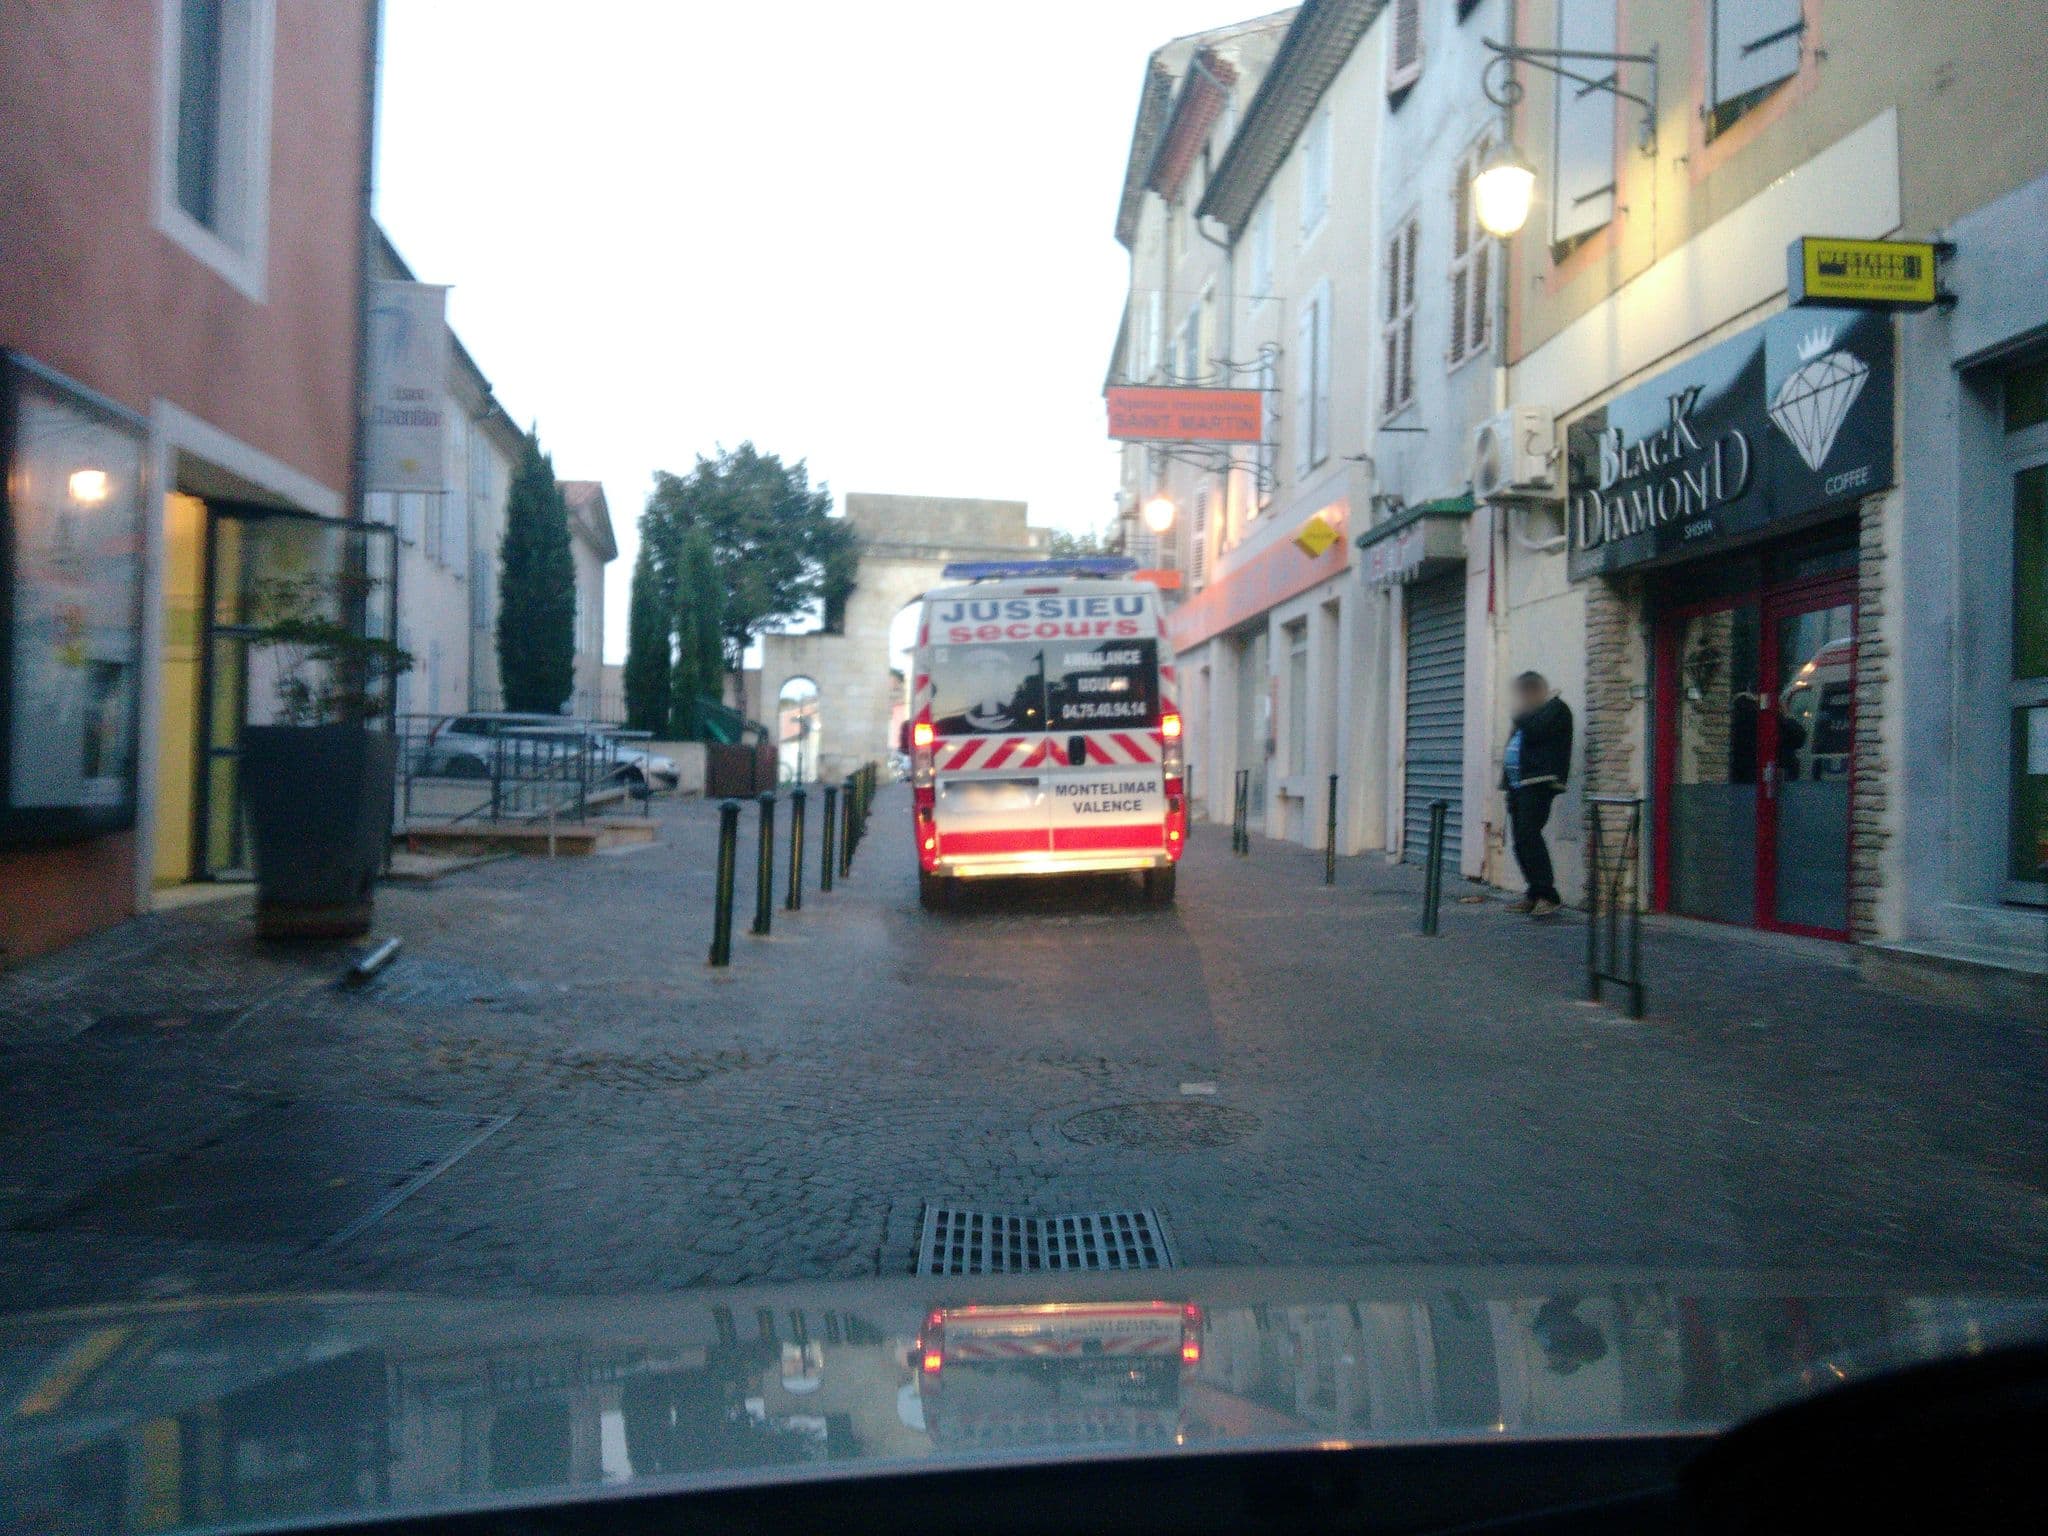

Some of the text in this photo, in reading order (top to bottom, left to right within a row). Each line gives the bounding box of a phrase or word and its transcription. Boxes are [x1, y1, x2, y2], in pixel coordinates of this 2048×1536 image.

[1113, 413, 1257, 433] SAINT MARTIN
[1825, 464, 1872, 496] COFFEE
[941, 596, 1144, 623] JUSSIEU
[949, 619, 1138, 643] secours
[1063, 650, 1141, 667] AMBULANCE
[1055, 780, 1157, 797] MONTELIMAR
[1072, 799, 1142, 814] VALENCE
